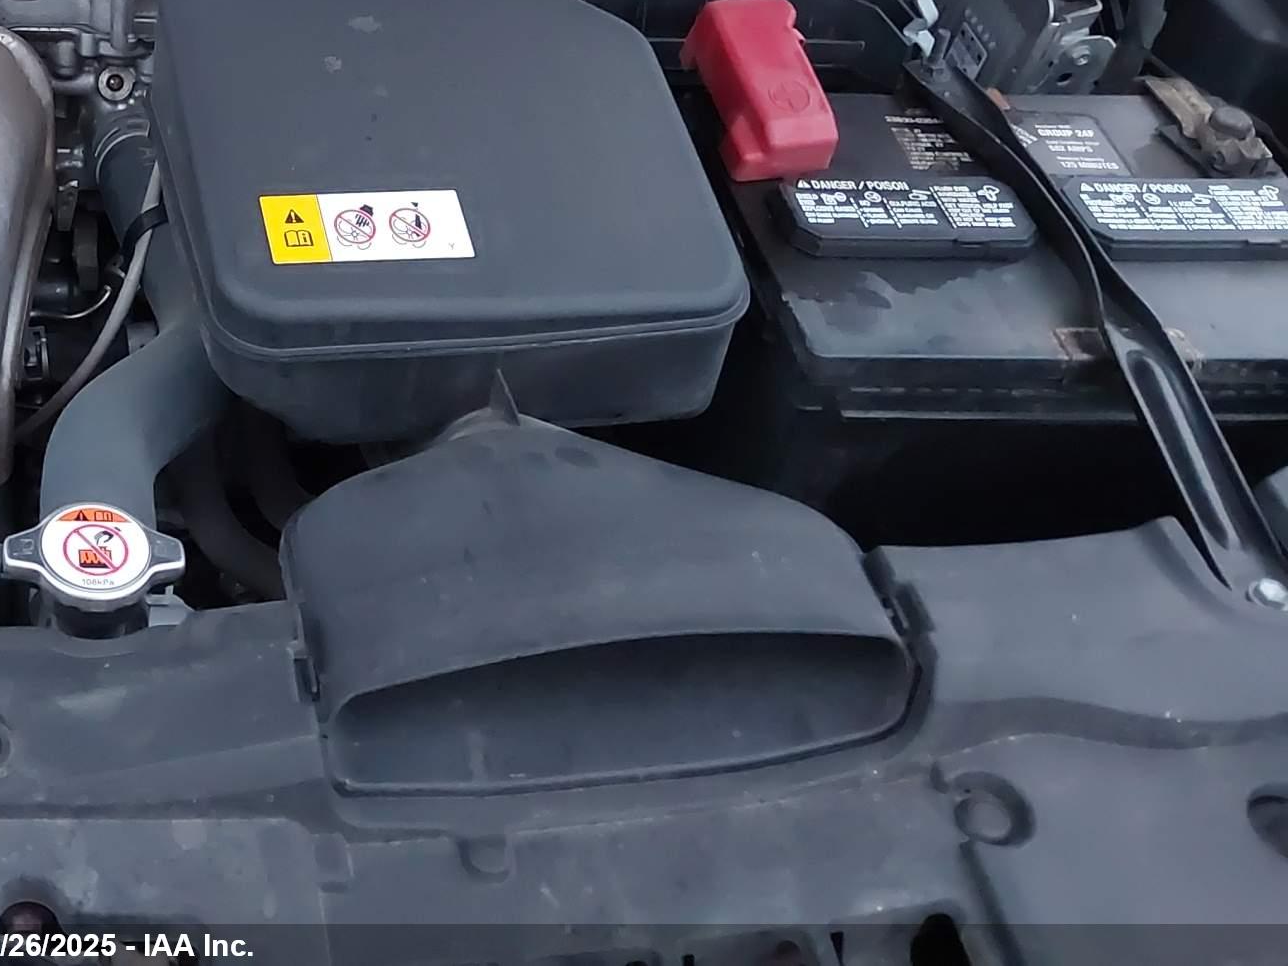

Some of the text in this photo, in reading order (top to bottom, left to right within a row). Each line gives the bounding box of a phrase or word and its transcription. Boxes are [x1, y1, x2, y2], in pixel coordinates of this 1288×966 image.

[810, 180, 857, 190] DANGER
[865, 181, 910, 191] POISON
[1093, 183, 1141, 192] DANGER
[1148, 183, 1192, 193] POISON
